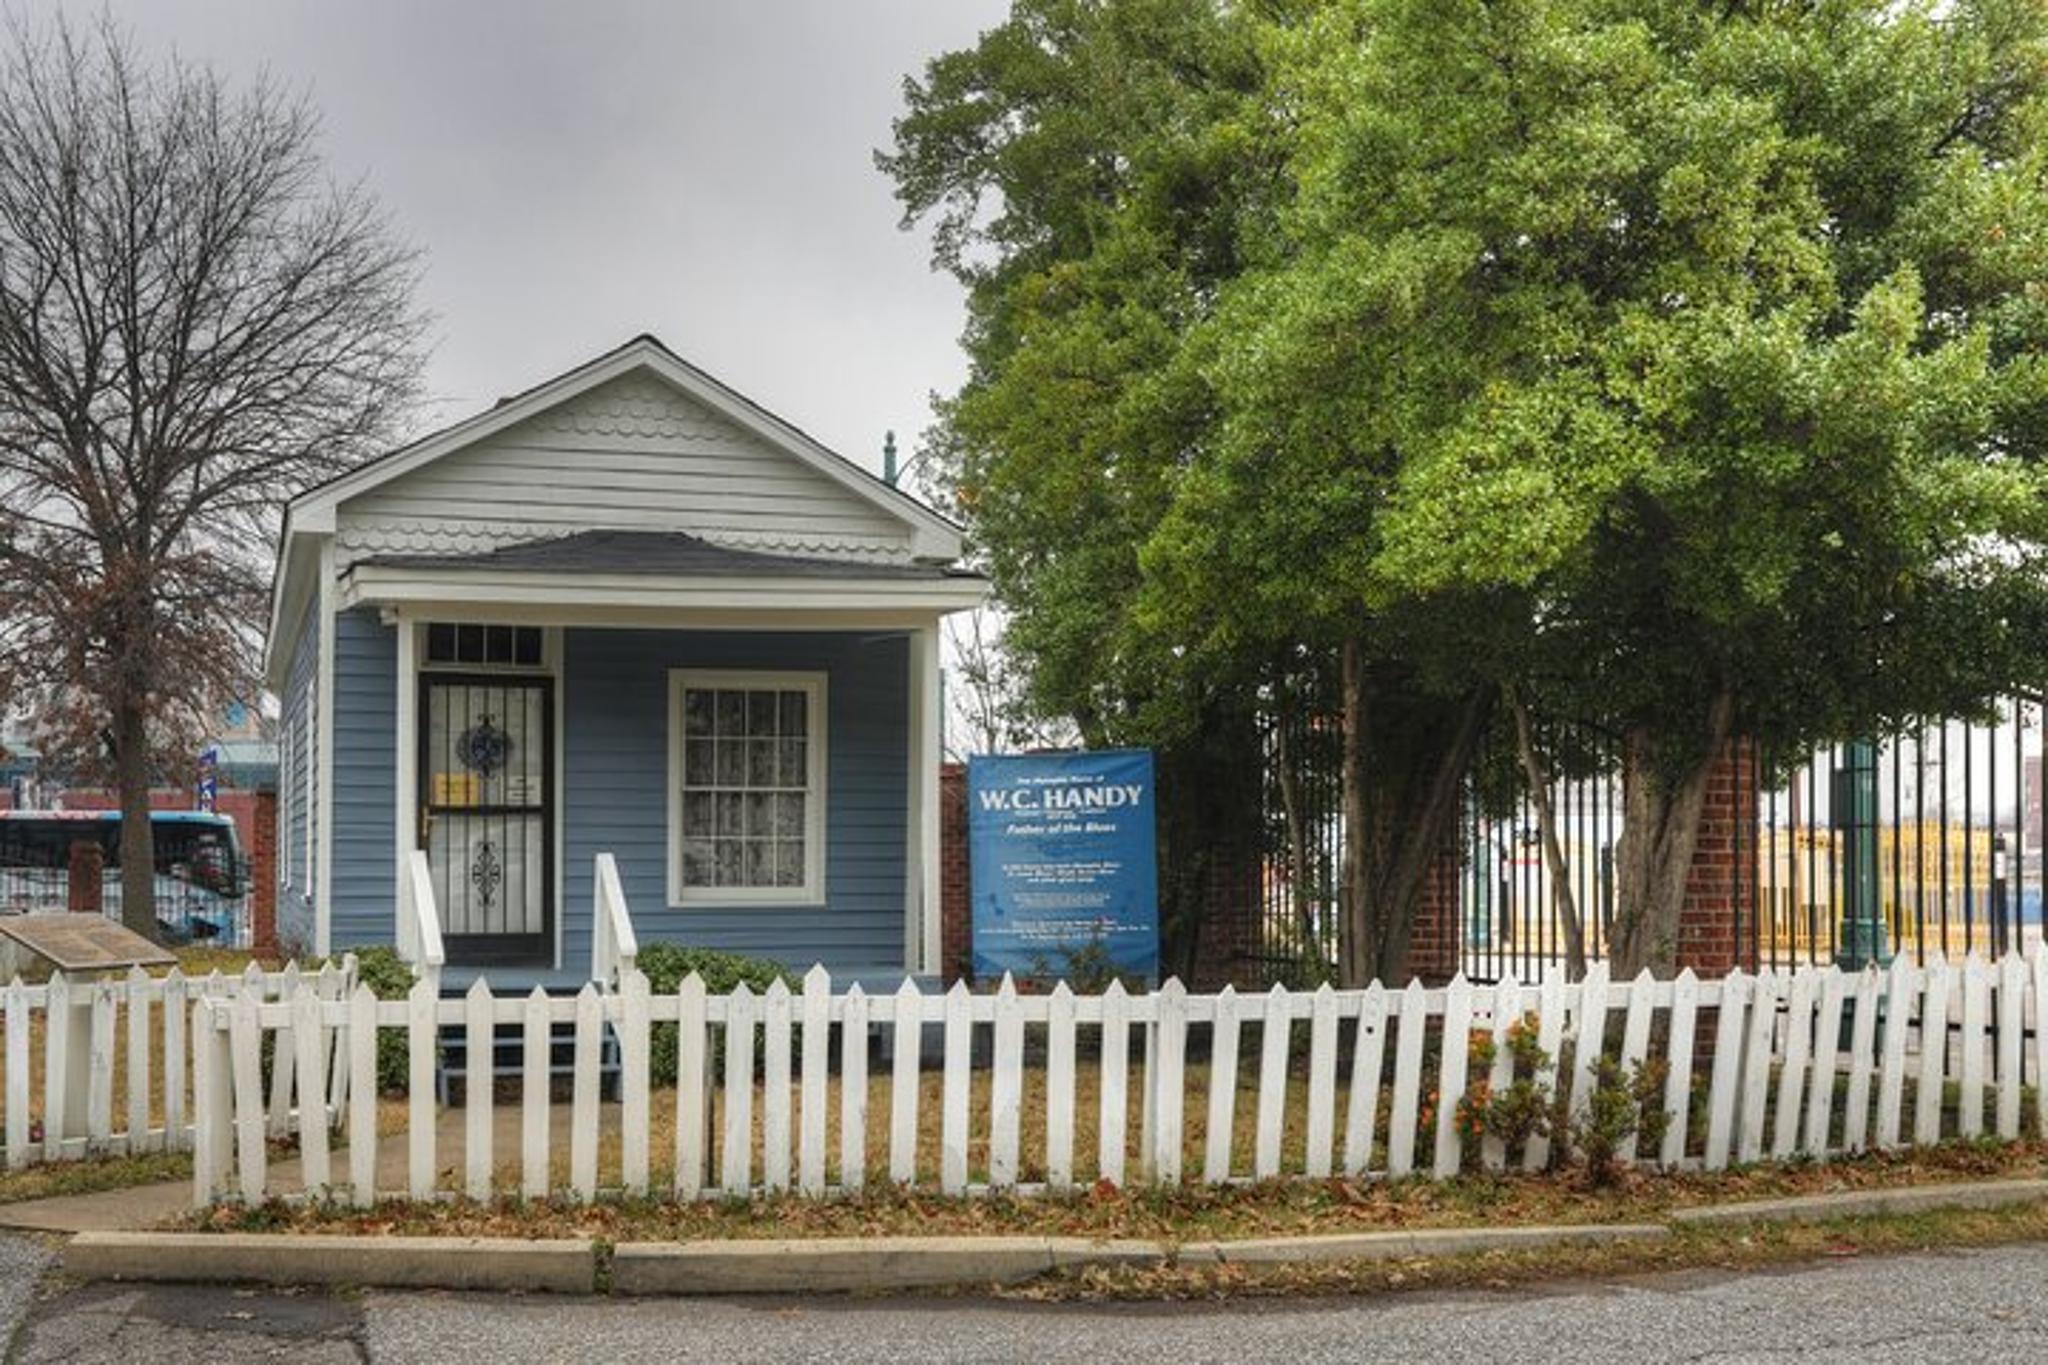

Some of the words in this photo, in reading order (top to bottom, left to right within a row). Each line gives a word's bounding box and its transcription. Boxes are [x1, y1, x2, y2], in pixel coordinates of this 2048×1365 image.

[979, 788, 1039, 810] W.C.
[1043, 785, 1142, 809] HANDY
[1006, 823, 1045, 835] Father
[1048, 822, 1062, 834] of
[1063, 821, 1082, 834] the
[1085, 820, 1116, 833] Blues
